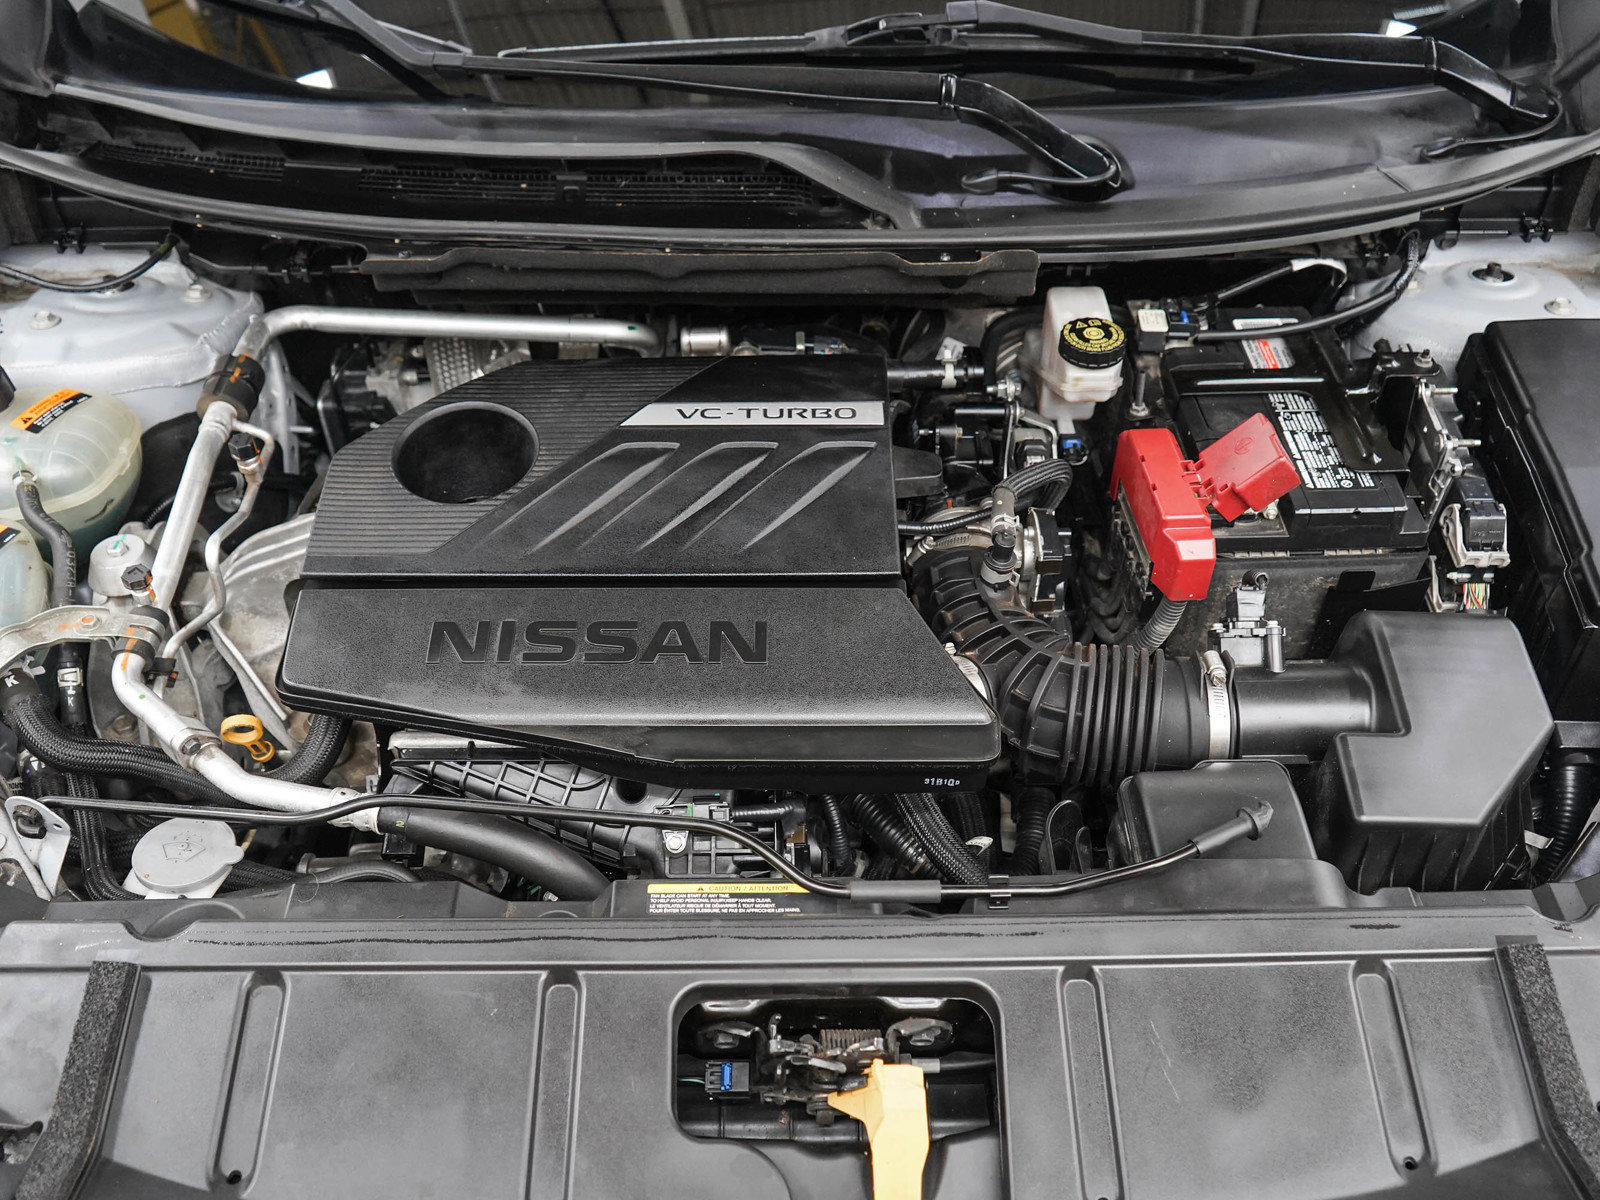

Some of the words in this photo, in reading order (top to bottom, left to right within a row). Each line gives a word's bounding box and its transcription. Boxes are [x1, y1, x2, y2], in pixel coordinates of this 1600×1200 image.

[676, 407, 857, 419] VC-TURBO
[425, 620, 768, 664] NISSAN
[4, 674, 19, 688] K
[67, 696, 74, 707] K
